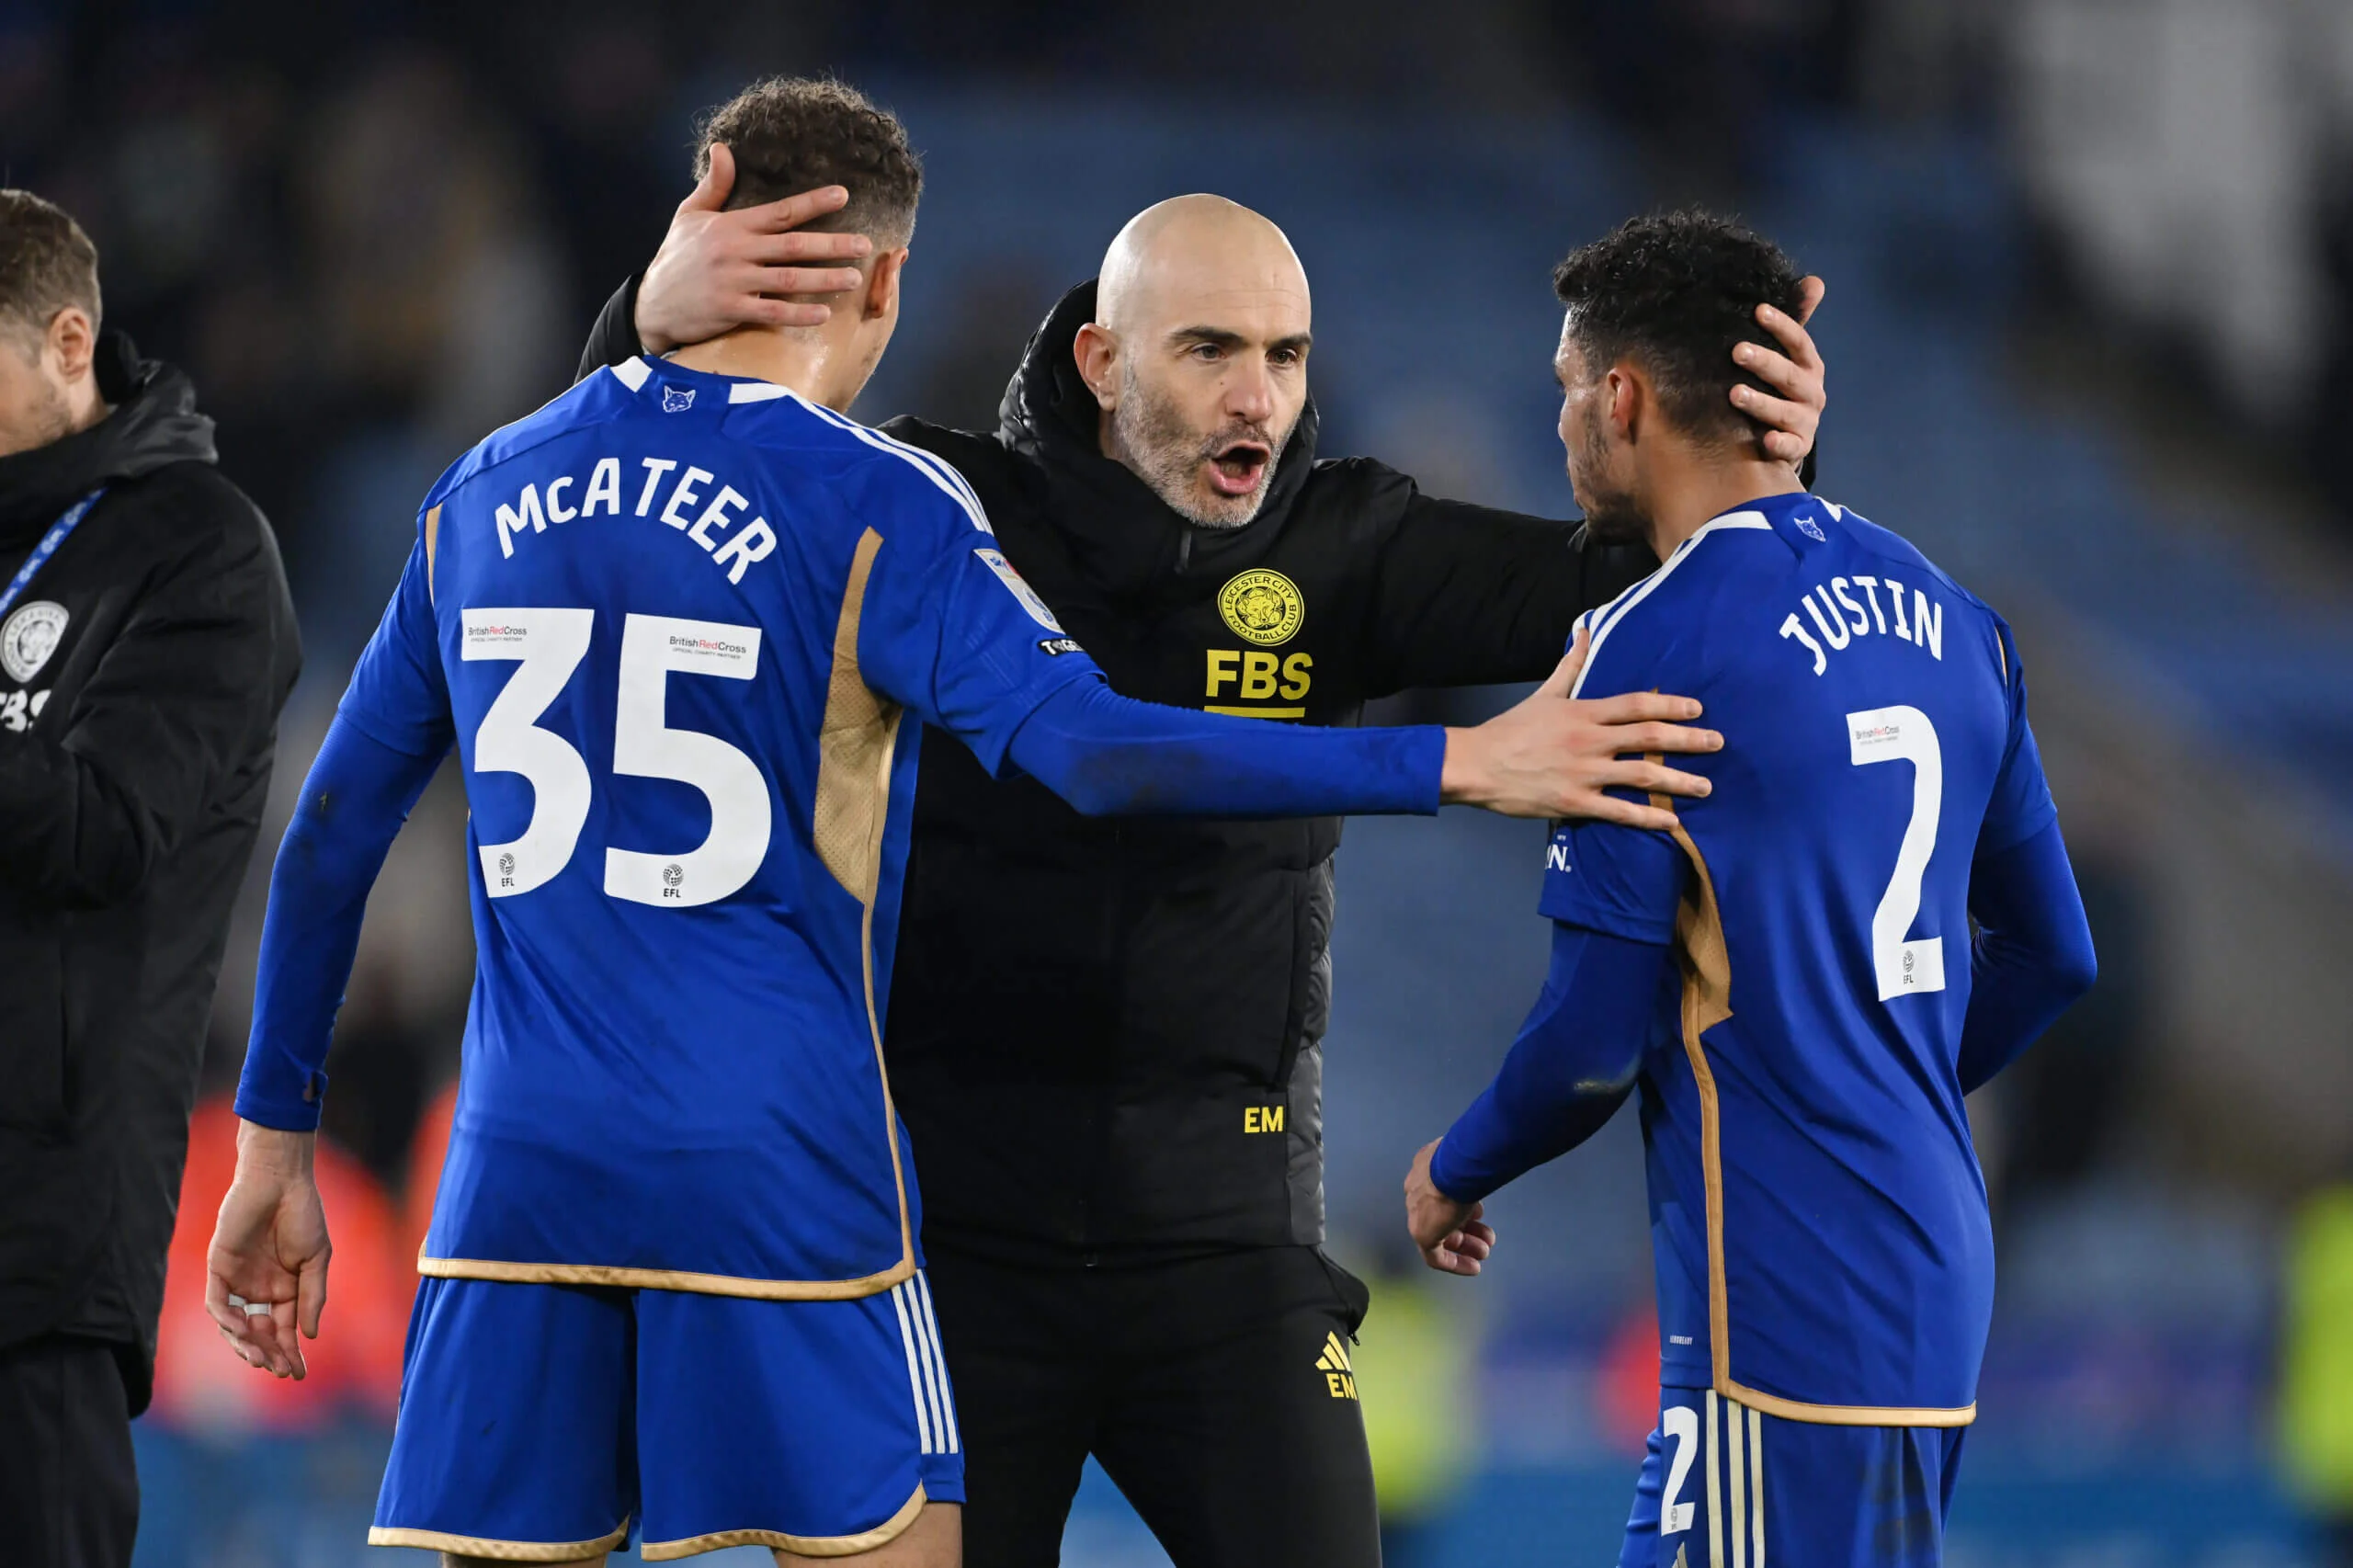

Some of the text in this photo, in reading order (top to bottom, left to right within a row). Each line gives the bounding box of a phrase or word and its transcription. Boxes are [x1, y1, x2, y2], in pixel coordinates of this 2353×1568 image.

[1224, 575, 1294, 610] LEICESTER CITY
[1228, 604, 1298, 641] FOOTBALL CLUB
[1779, 575, 1942, 677] JUSTIN
[1205, 649, 1313, 700] FBS
[461, 608, 772, 908] 35
[1846, 705, 1946, 1002] 2
[501, 878, 515, 888] EFL
[663, 888, 681, 898] EFL
[1904, 974, 1914, 984] EFL
[1244, 1106, 1284, 1133] EM
[1326, 1373, 1358, 1401] EM
[1661, 1405, 1699, 1537] 2
